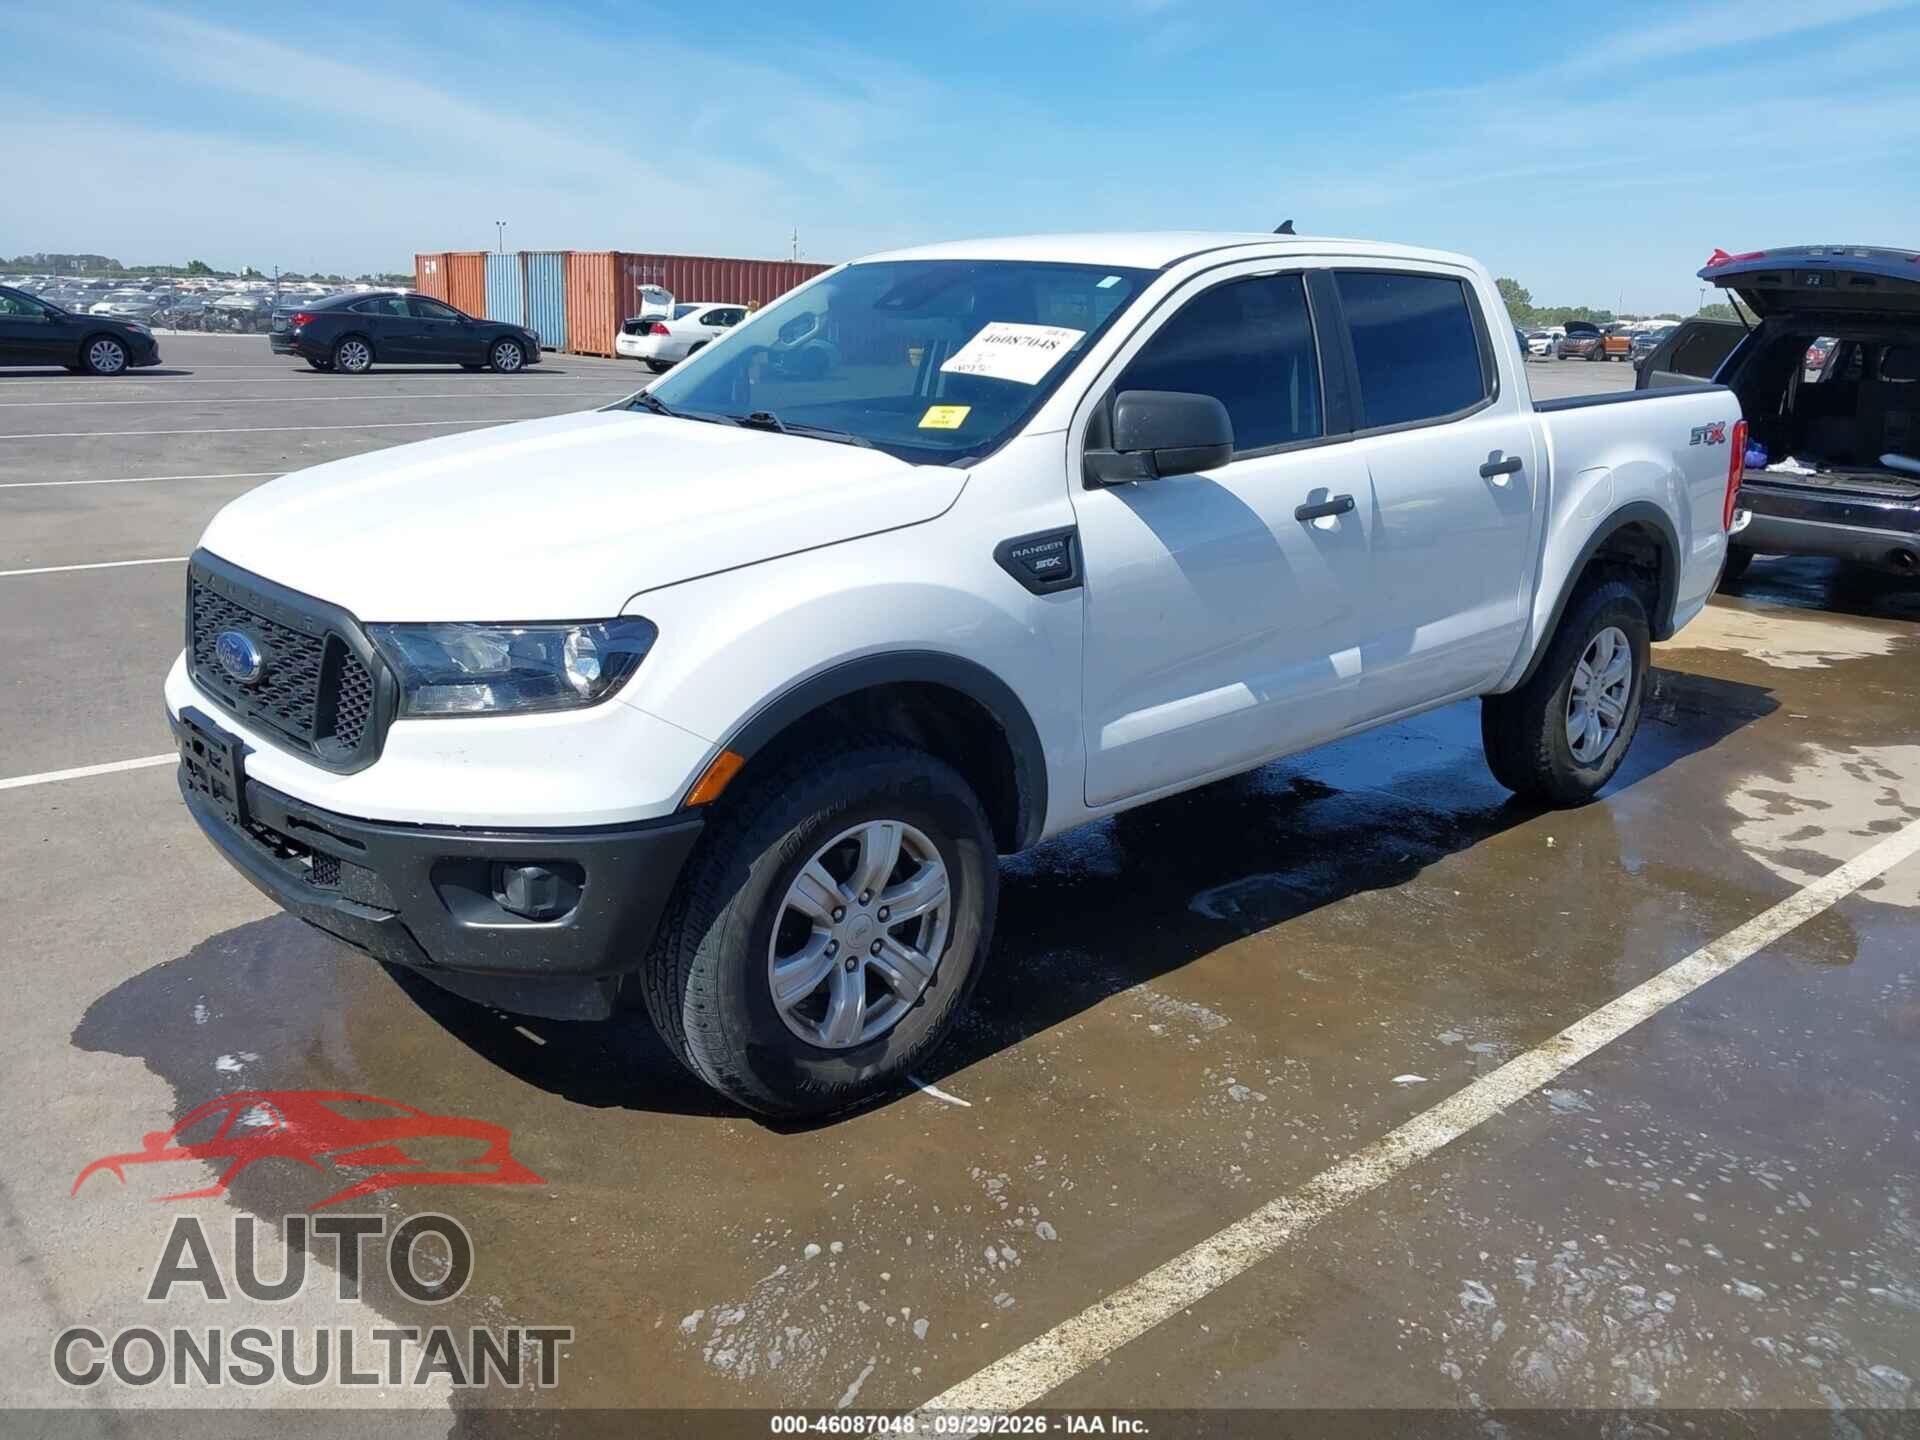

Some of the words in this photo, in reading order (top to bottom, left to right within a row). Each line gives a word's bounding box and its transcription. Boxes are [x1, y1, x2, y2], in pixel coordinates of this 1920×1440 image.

[982, 333, 1061, 351] 46087048
[1689, 420, 1726, 446] STX
[1011, 541, 1064, 558] RANGER
[1035, 556, 1062, 570] STX
